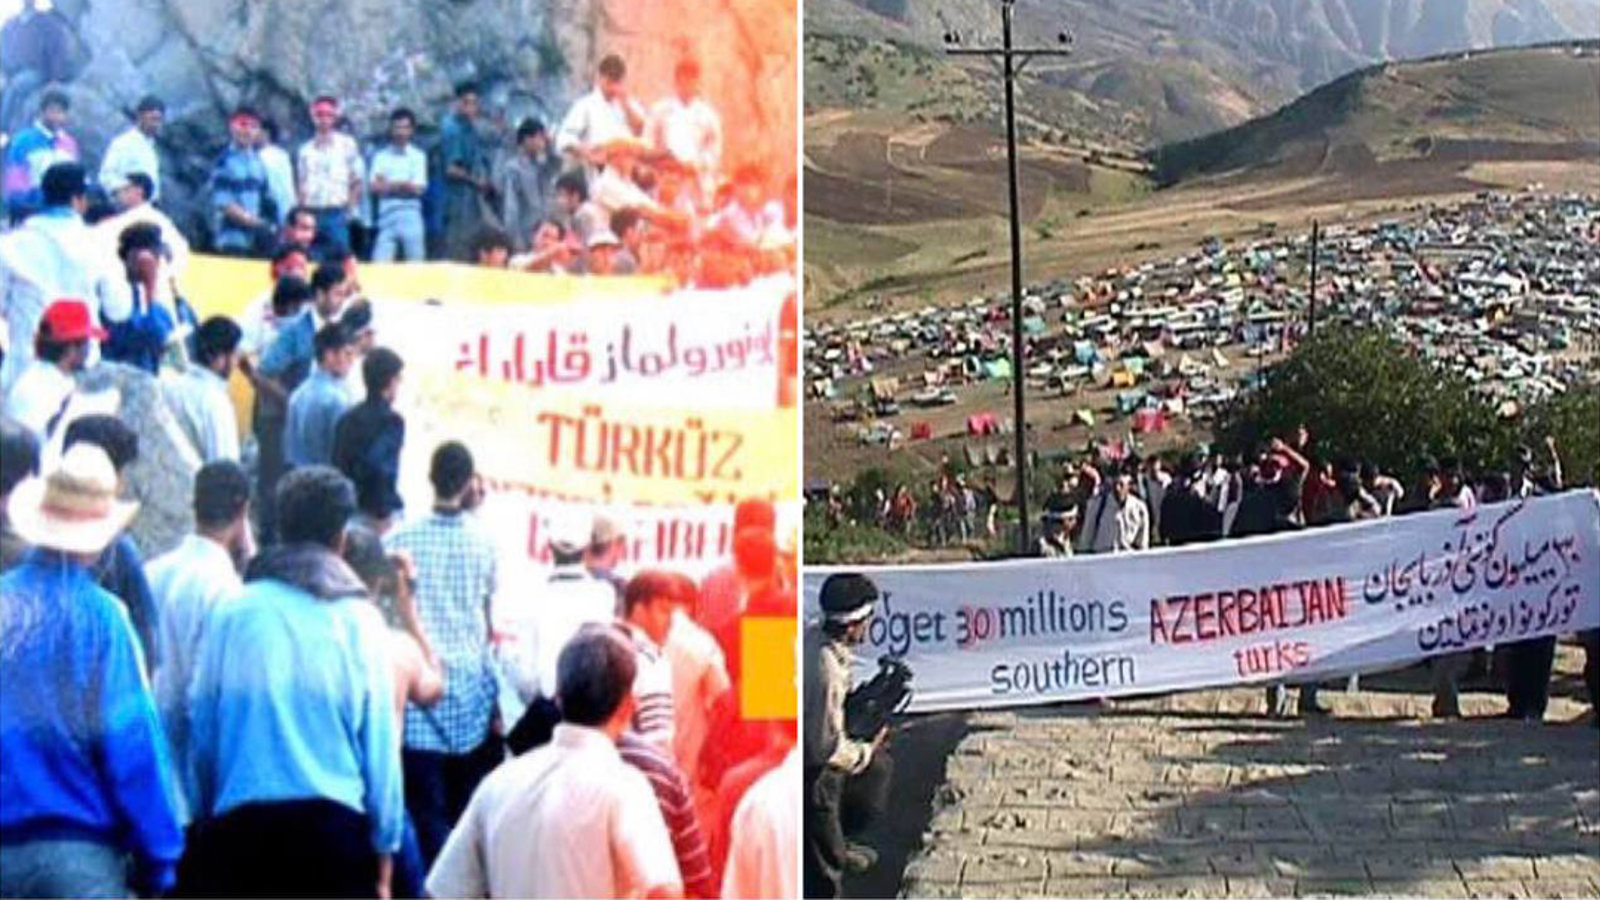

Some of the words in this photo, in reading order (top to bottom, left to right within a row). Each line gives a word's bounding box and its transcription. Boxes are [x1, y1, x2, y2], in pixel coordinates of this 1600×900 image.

[536, 404, 743, 481] TÜRKÜZ
[956, 603, 992, 646] 30
[1000, 591, 1128, 638] millions
[1149, 576, 1348, 645] AZERBAIJAN
[991, 650, 1136, 695] southern
[1233, 640, 1309, 678] turks
